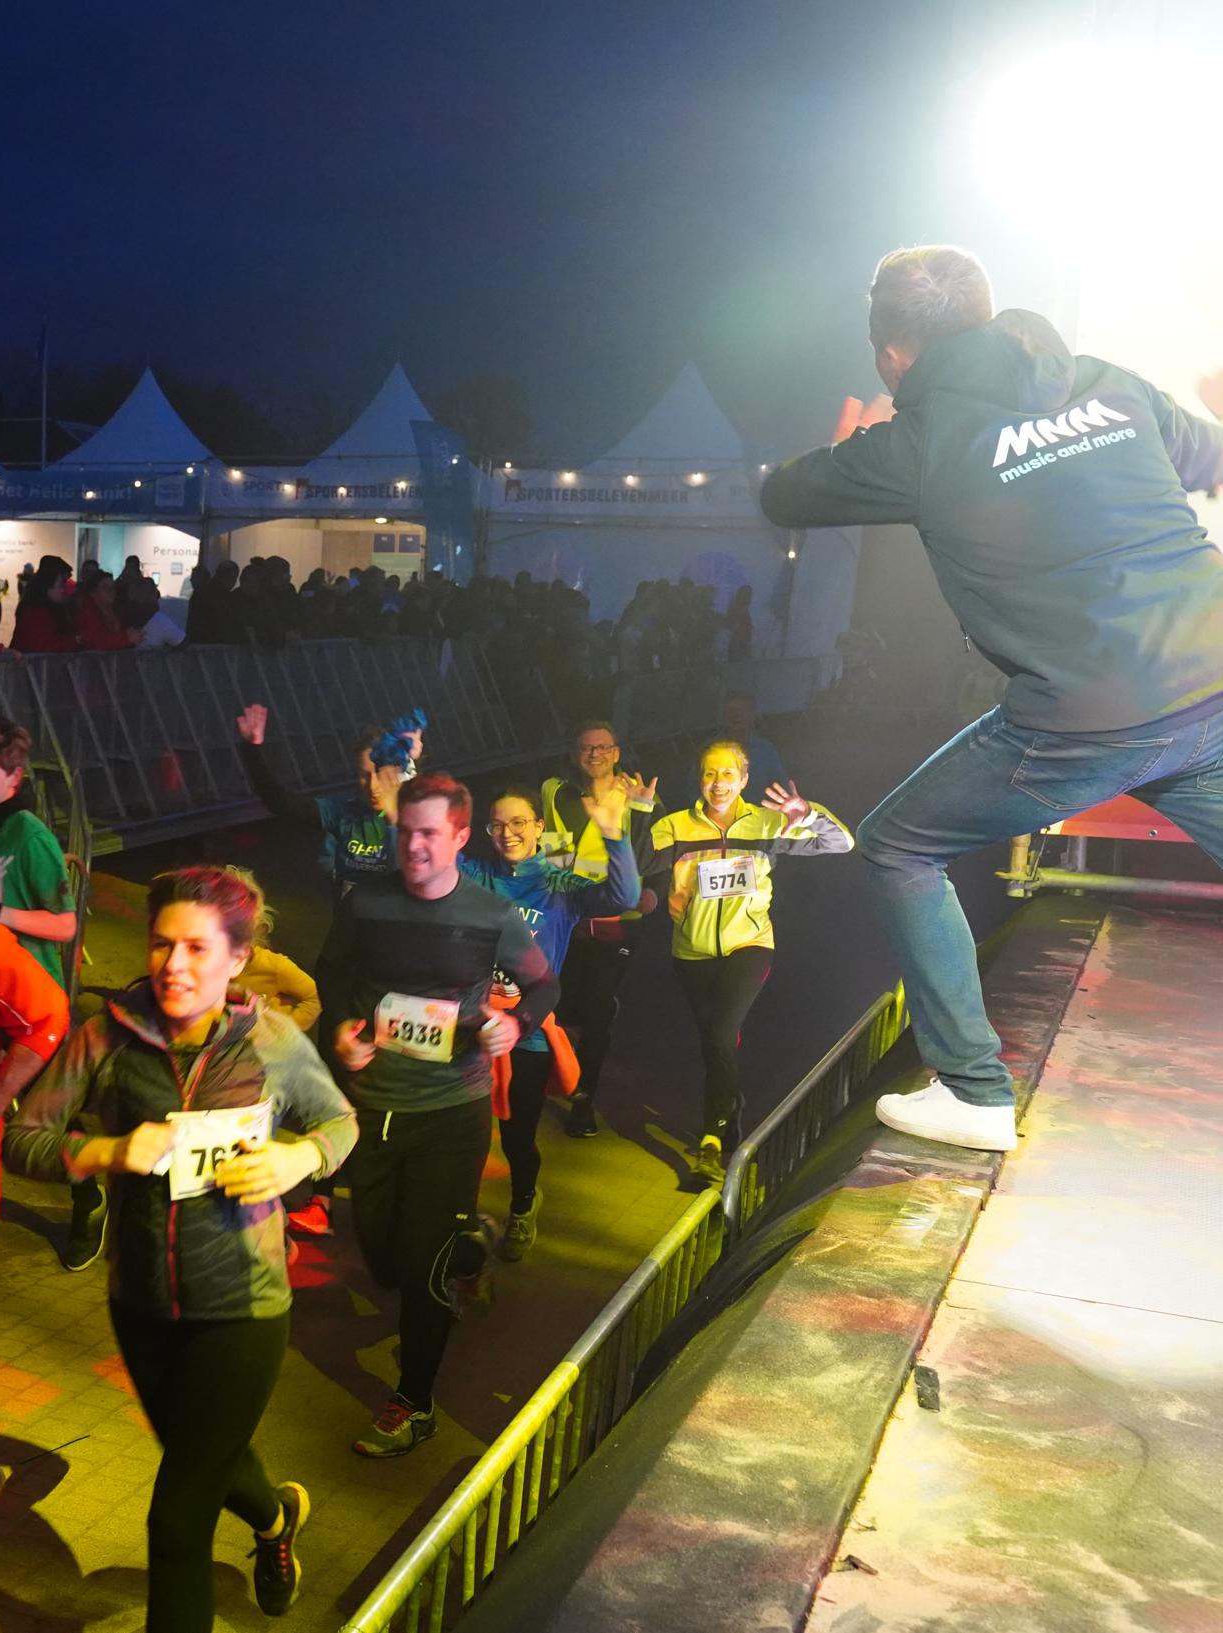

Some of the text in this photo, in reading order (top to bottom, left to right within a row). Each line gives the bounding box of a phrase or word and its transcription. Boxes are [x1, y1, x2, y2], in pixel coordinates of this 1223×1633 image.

[992, 399, 1132, 468] MNM
[999, 427, 1137, 484] music and more
[709, 872, 747, 891] 5774
[388, 1018, 442, 1046] 5938
